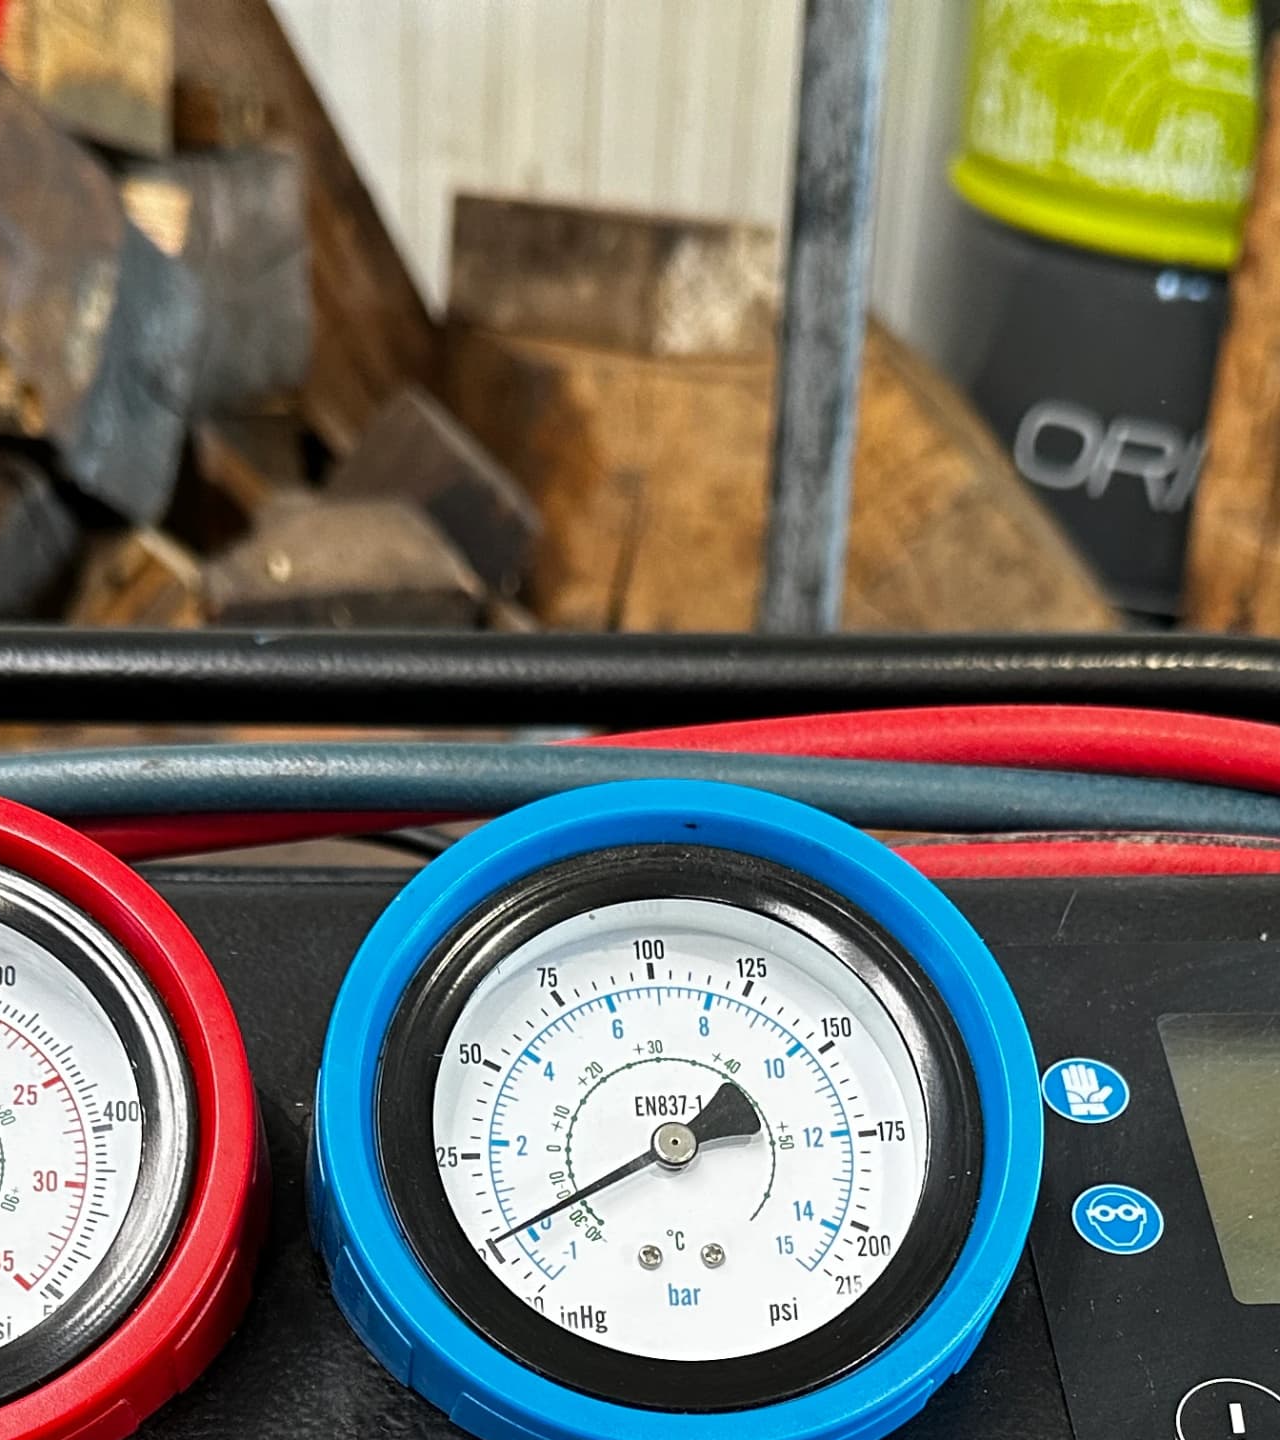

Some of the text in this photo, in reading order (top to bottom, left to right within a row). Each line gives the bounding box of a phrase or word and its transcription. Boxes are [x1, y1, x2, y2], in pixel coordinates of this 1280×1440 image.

[633, 939, 665, 960] 100
[537, 967, 558, 988] 75
[736, 957, 767, 979] 125
[611, 1019, 624, 1039] 6
[699, 1015, 710, 1037] 8
[820, 1016, 852, 1038] 150
[459, 1043, 482, 1065] 50
[543, 1061, 555, 1082] 4
[763, 1058, 785, 1079] 10
[13, 1085, 38, 1106] 25
[635, 1095, 703, 1117] EN837-1
[103, 1101, 139, 1122] 400
[803, 1127, 824, 1148] 12
[876, 1120, 906, 1142] 175
[516, 1135, 528, 1156] 2
[437, 1146, 458, 1168] 25
[33, 1170, 58, 1192] 30
[792, 1200, 815, 1222] 14
[562, 1240, 577, 1260] -1
[775, 1235, 795, 1255] 15
[857, 1235, 891, 1257] 200
[668, 1282, 701, 1307] bar
[835, 1275, 863, 1295] 215
[560, 1305, 609, 1334] inHg
[769, 1297, 799, 1327] psi
[1229, 1403, 1246, 1434] 1
